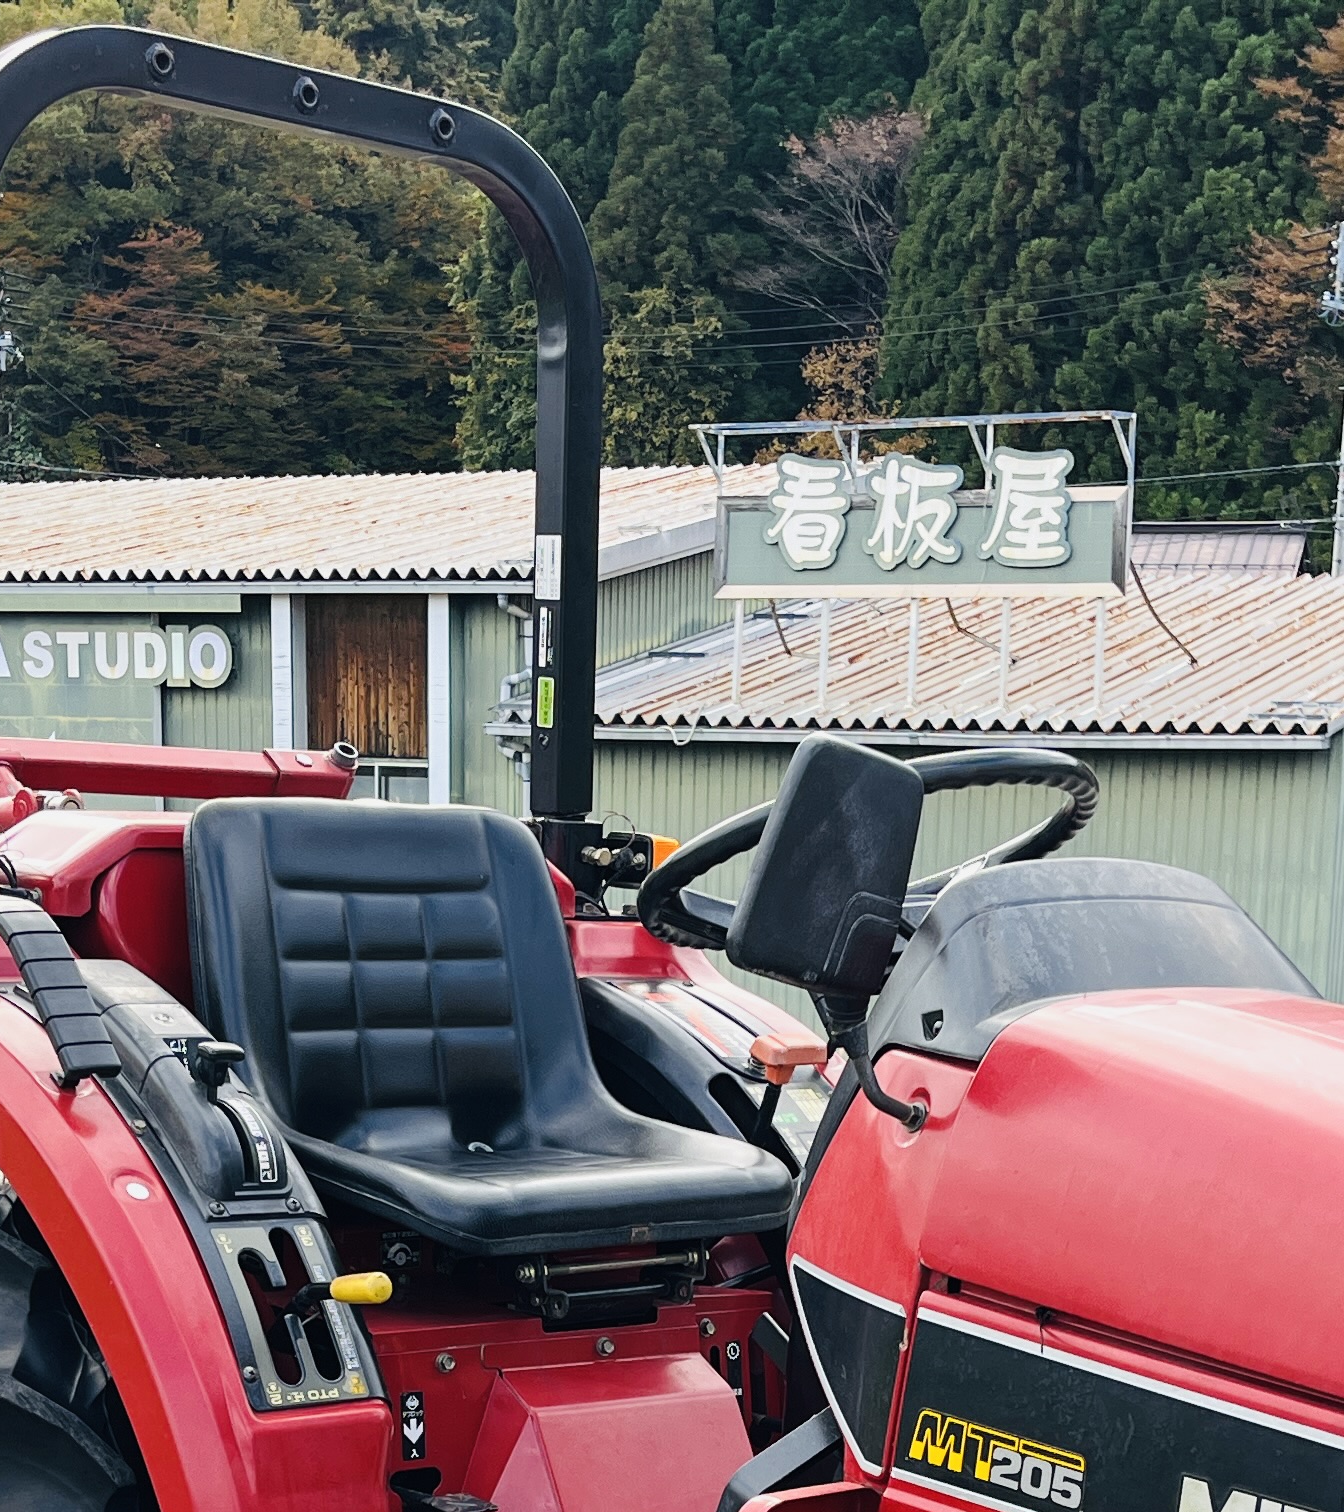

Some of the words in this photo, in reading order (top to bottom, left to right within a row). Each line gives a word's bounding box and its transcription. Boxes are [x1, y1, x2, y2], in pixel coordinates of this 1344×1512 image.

[768, 452, 1069, 565] 看板屋
[22, 630, 228, 681] STUDIO
[307, 1387, 340, 1401] PTO
